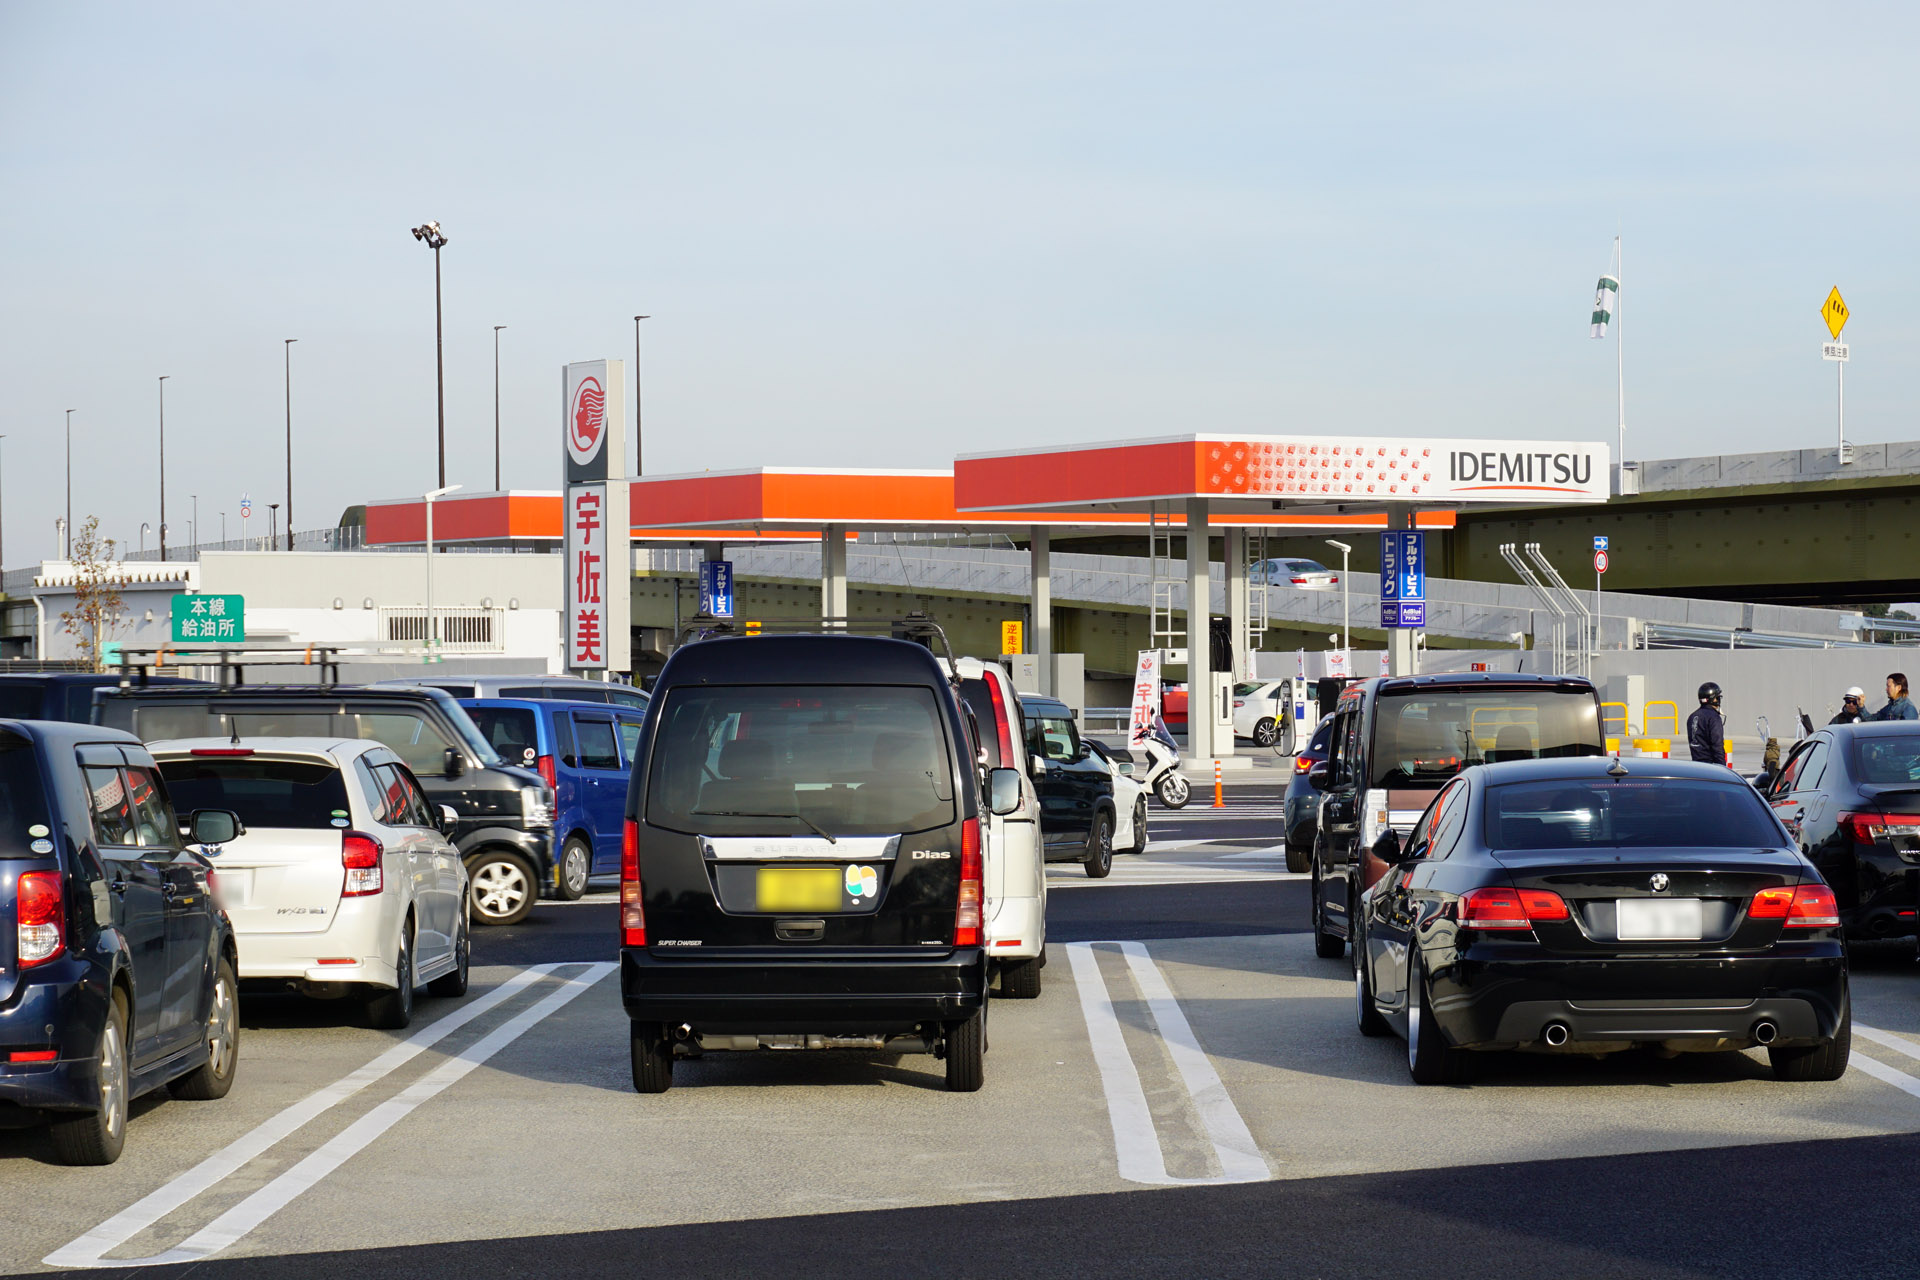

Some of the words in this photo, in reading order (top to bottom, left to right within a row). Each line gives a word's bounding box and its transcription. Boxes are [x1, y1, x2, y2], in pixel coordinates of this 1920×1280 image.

[1450, 451, 1591, 484] IDEMITSU
[576, 491, 601, 662] 宇佐美
[1384, 537, 1395, 595] トラック
[1406, 535, 1418, 596] フルサービス
[190, 598, 226, 616] 本線
[701, 567, 709, 612] トラック
[717, 565, 727, 613] フルサービス
[181, 618, 236, 637] 給油所
[912, 851, 951, 859] Dias
